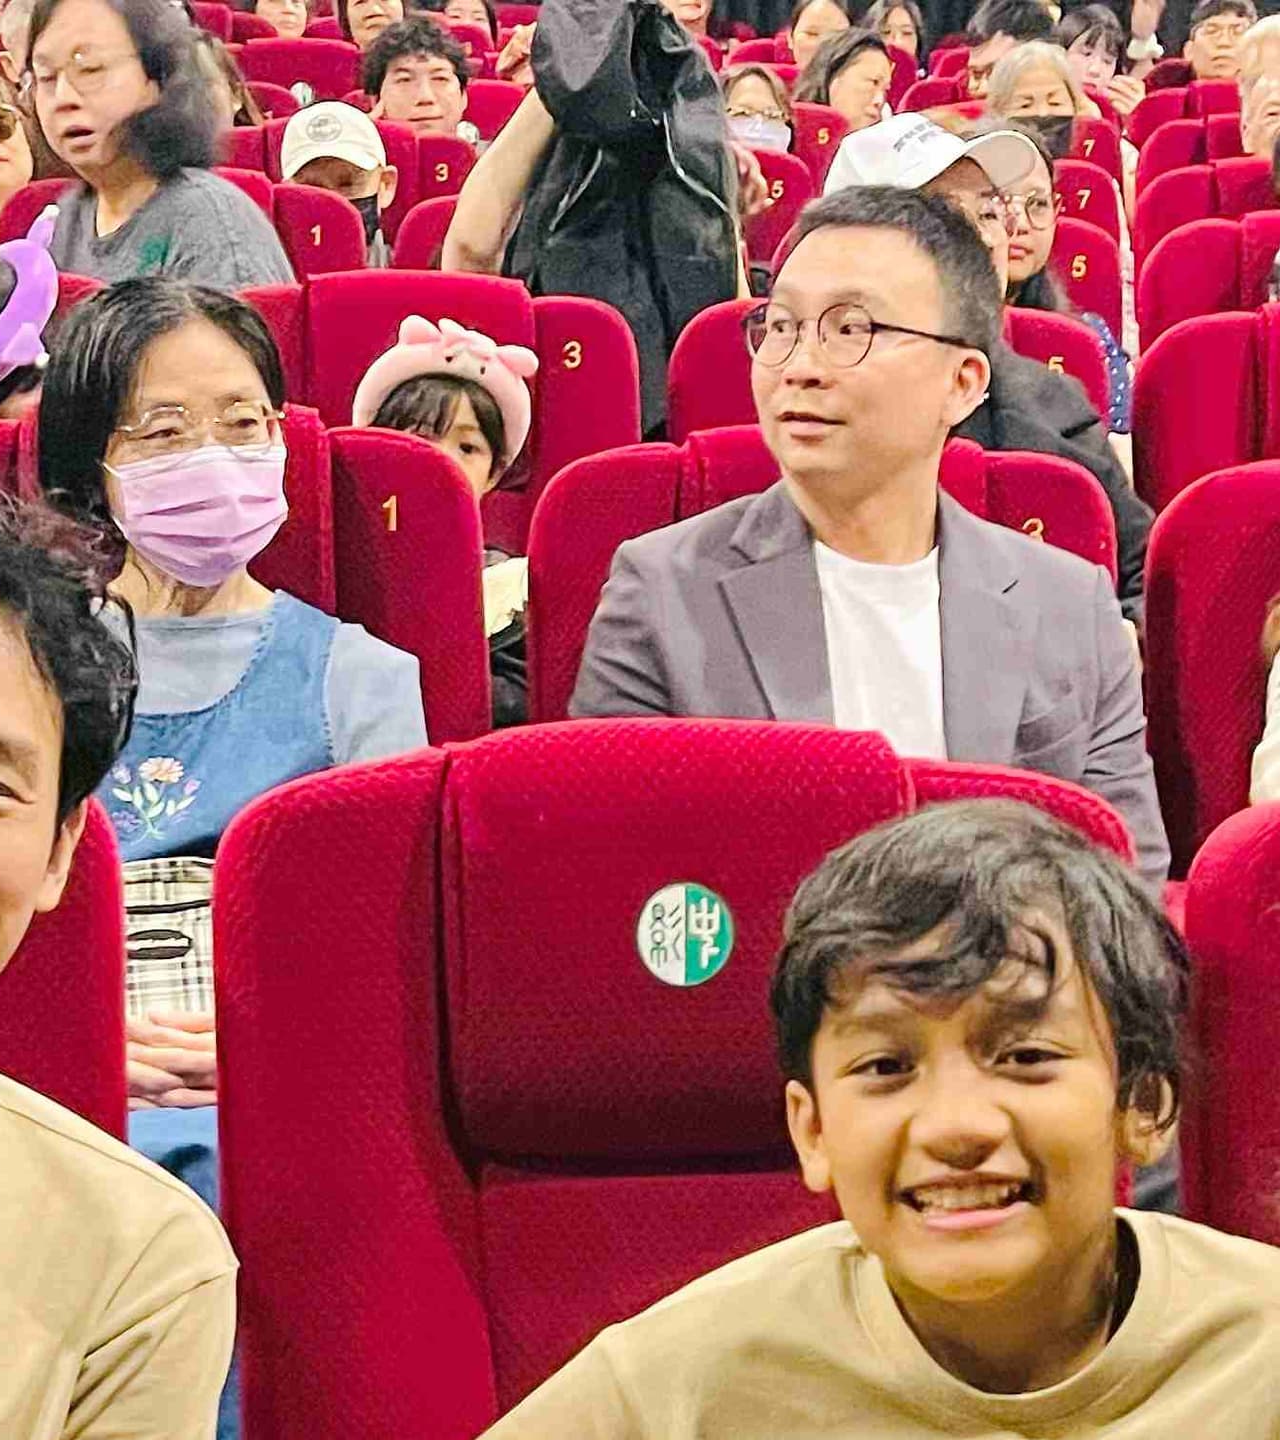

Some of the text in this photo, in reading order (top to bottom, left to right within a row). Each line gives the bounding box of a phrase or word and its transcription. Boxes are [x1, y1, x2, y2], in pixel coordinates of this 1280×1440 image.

[1082, 139, 1096, 158] 7
[435, 163, 449, 182] 3
[1077, 189, 1091, 209] 7
[310, 225, 321, 246] 1
[1071, 255, 1087, 278] 5
[563, 340, 582, 368] 3
[381, 495, 398, 531] 1
